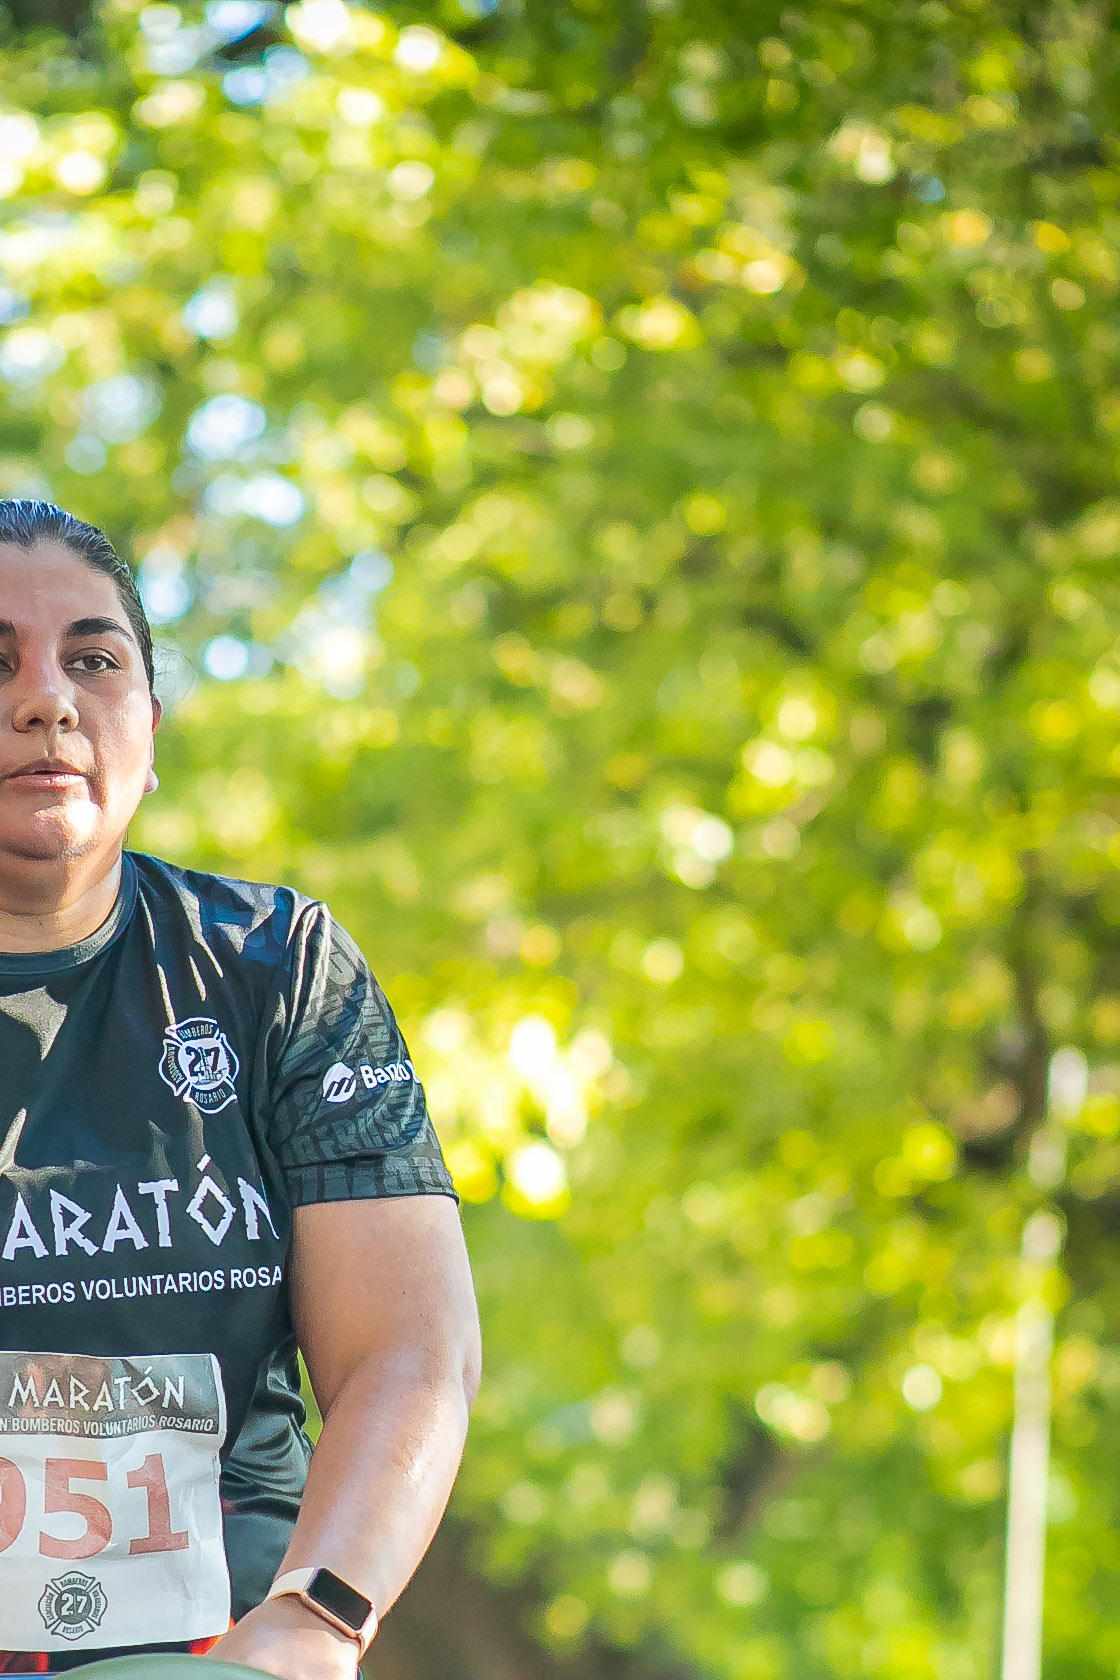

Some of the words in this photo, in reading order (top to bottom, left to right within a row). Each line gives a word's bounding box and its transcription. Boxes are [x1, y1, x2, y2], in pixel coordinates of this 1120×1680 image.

[185, 1045, 221, 1078] 27
[194, 1088, 227, 1104] ROSARIO
[80, 1269, 226, 1301] VOLUNTARIOS
[7, 1365, 186, 1412] MARATÓN
[11, 1417, 81, 1434] BOMBEROS
[83, 1414, 156, 1437] VOLUNTARIOS
[158, 1415, 214, 1432] ROSARIO
[61, 1592, 88, 1616] 27
